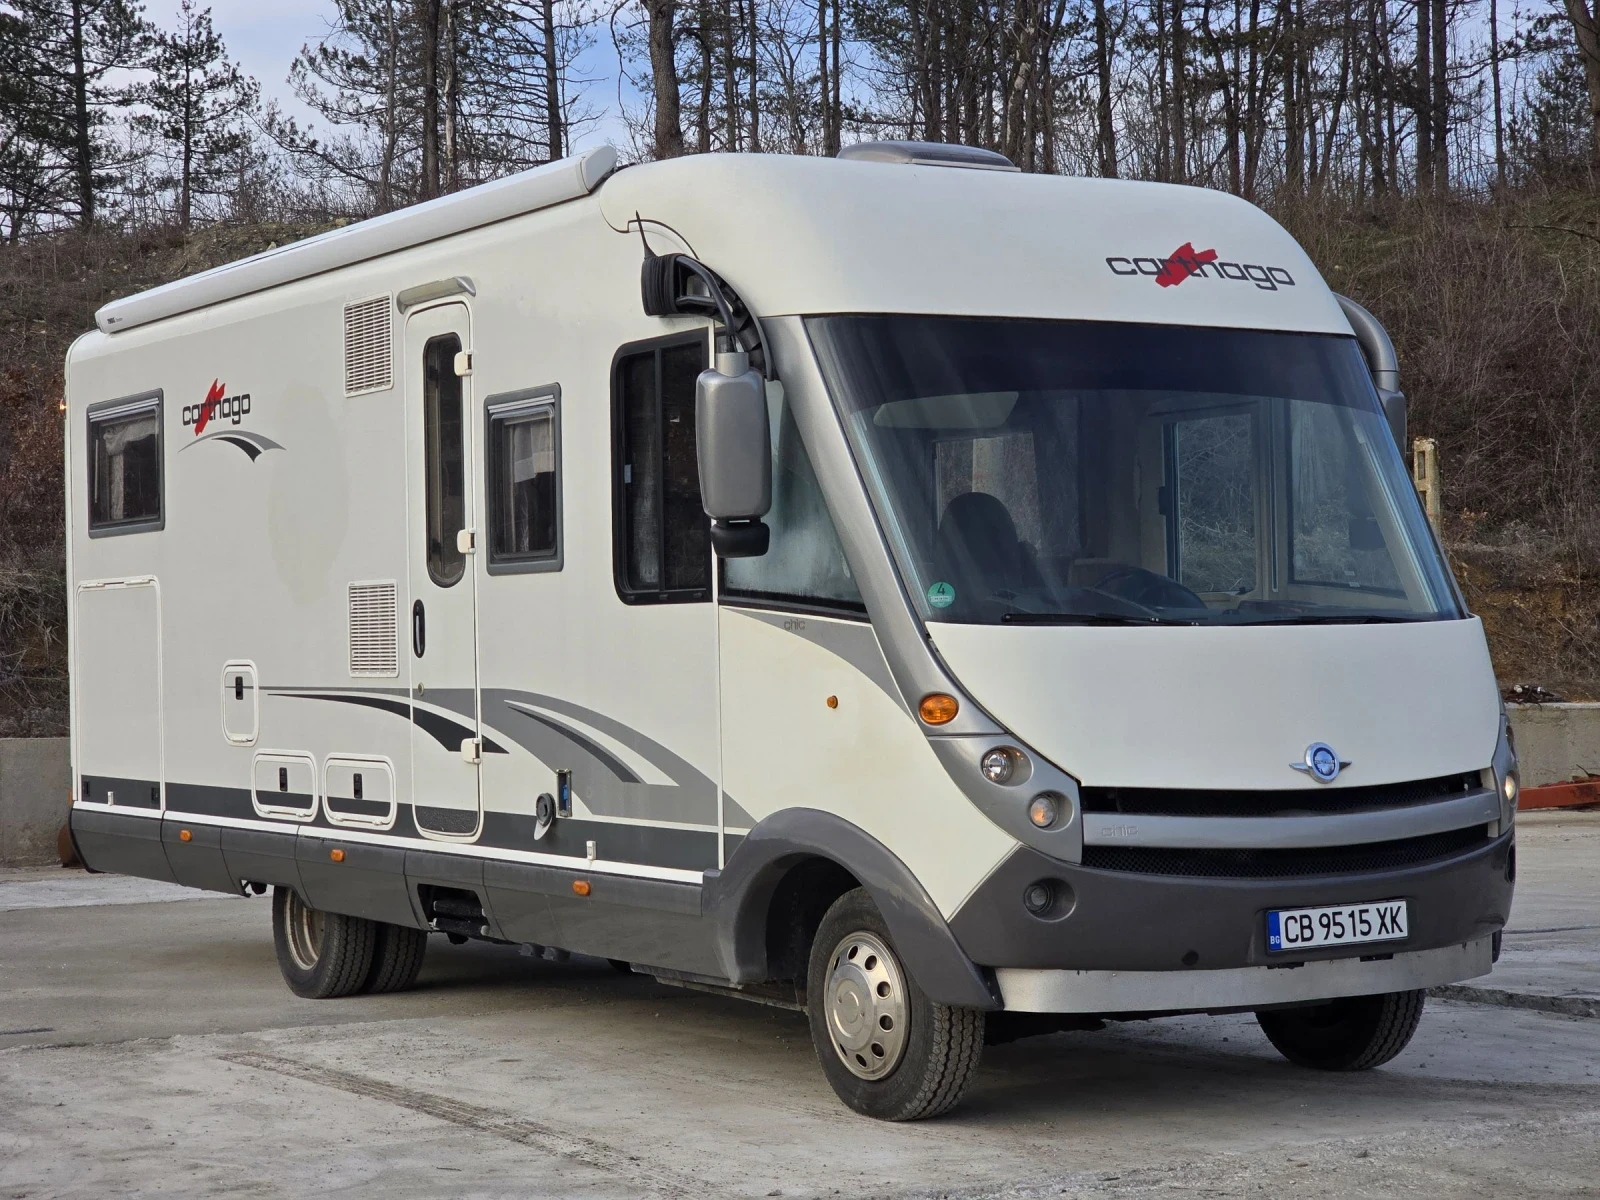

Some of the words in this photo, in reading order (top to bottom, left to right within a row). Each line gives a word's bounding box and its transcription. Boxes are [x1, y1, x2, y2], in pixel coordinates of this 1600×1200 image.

[1105, 256, 1296, 291] carthago
[182, 393, 251, 426] carthago
[937, 582, 946, 595] 4
[783, 618, 806, 630] chic
[1101, 823, 1139, 837] chic
[1284, 914, 1314, 943] CB
[1318, 909, 1372, 940] 9515
[1376, 905, 1404, 936] XK
[1270, 935, 1281, 945] BG
